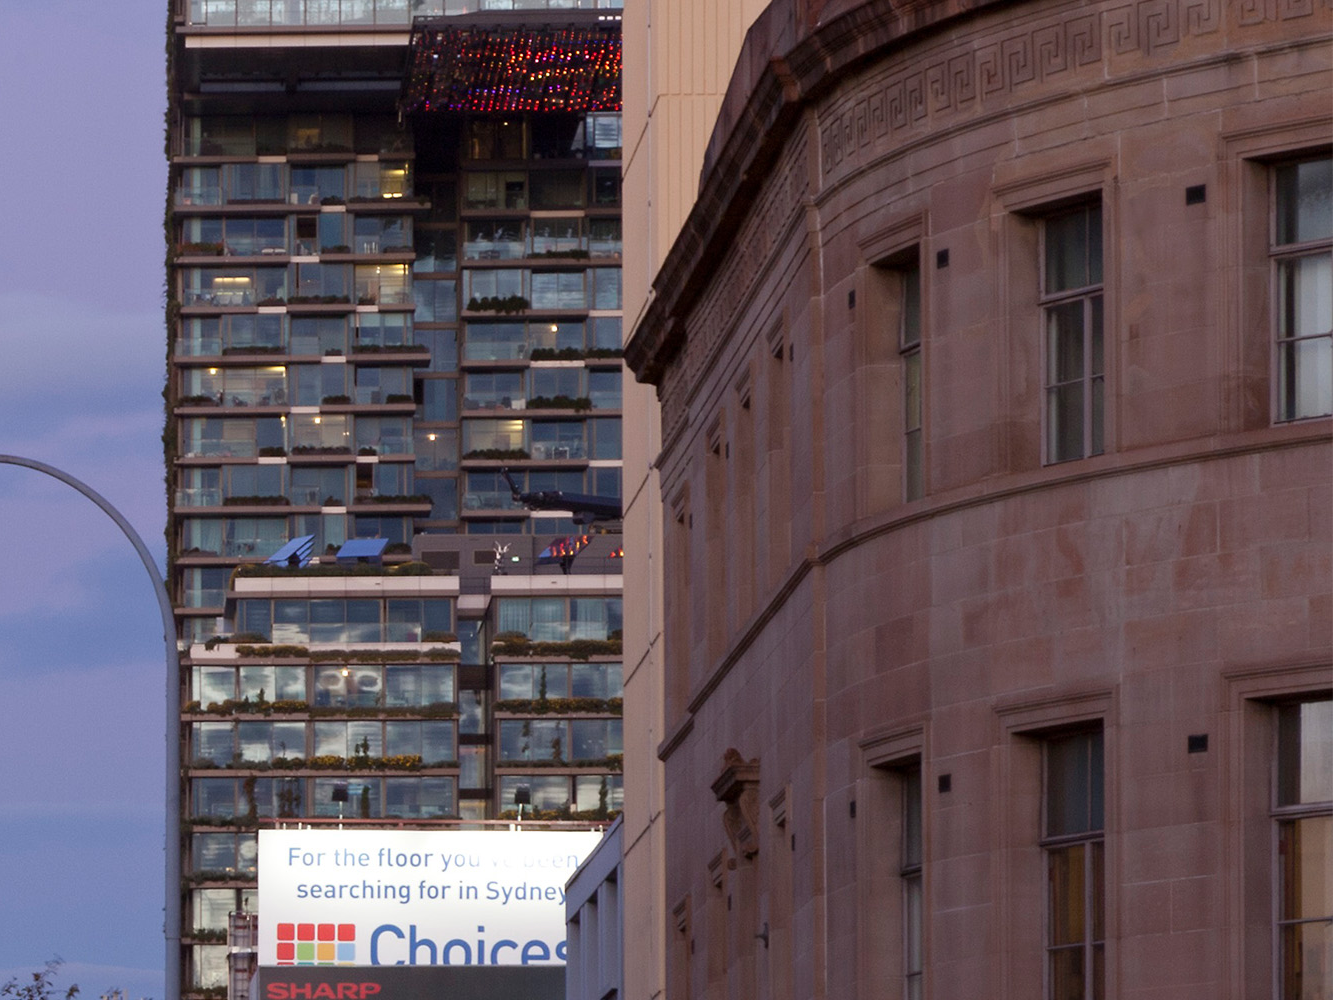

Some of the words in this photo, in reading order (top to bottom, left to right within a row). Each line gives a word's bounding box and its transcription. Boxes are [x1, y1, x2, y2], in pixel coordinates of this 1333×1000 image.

[288, 848, 325, 867] For
[334, 848, 369, 867] the
[378, 848, 433, 868] floor
[297, 880, 410, 904] searching
[418, 880, 451, 900] for
[459, 880, 479, 900] in
[486, 881, 567, 905] Sydney
[266, 982, 381, 1000] SHARP
